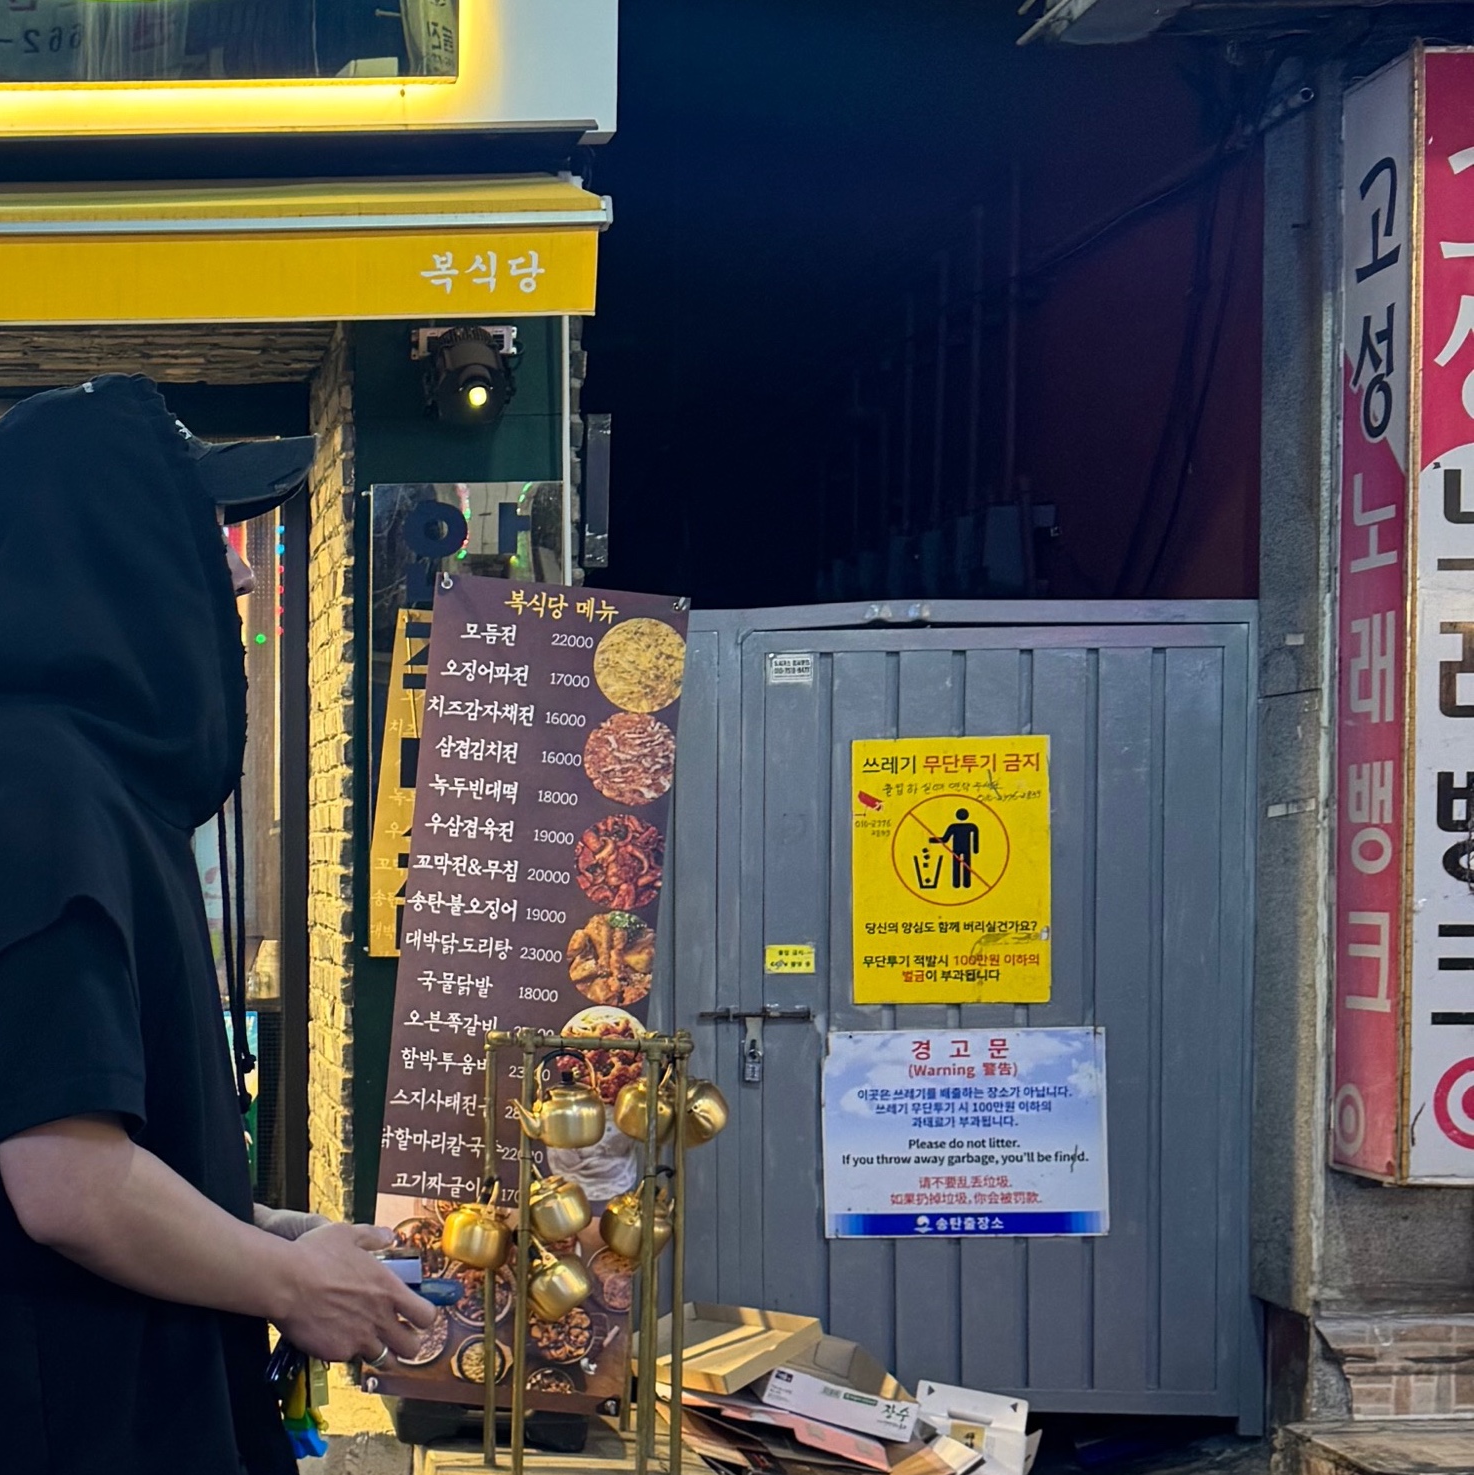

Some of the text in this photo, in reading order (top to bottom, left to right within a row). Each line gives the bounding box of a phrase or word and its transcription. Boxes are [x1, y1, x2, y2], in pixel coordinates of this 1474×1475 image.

[420, 250, 546, 294] 복식당
[1345, 156, 1402, 1013] 고성 노래뱅크
[504, 590, 619, 624] 복식당 메뉴
[460, 623, 593, 649] 모듬전 22000
[440, 659, 590, 688] 오징어파전 17000
[427, 695, 586, 727] 치즈감자채전 16000
[435, 736, 582, 767] 삼겹김치전 16000
[862, 752, 1041, 774] 쓰레기 무단투기 금지
[429, 774, 578, 806] 녹두빈대떡 18000
[424, 813, 575, 846] 우삼겹육전 19000
[412, 853, 571, 885] 꼬막전&무침 20000
[525, 908, 567, 924] 19000
[865, 921, 1037, 935] 당신의 양심도 함께 버리실건가요?
[519, 947, 563, 964] 23000
[863, 954, 1040, 967] 무단투기 적발시 100만원 이하의
[417, 970, 559, 1003] 국물닭발 18000
[902, 969, 1000, 982] 벌금이 부과됩니다
[509, 1066, 551, 1082] 230
[390, 1088, 487, 1118] 스지사태전
[857, 1086, 1073, 1101] 이곳은 쓰레기를 배출하는 장소가 아닙니다.
[875, 1100, 1052, 1115] 쓰레기 무단투기 시 100만원 이하의
[912, 1115, 1018, 1129] 과태료가 부과됩니다.
[908, 1138, 1021, 1150] Please do not litter.
[842, 1151, 1089, 1168] If you throw away garbage, you'll be fined.
[936, 1216, 1004, 1231] 송탄출장소
